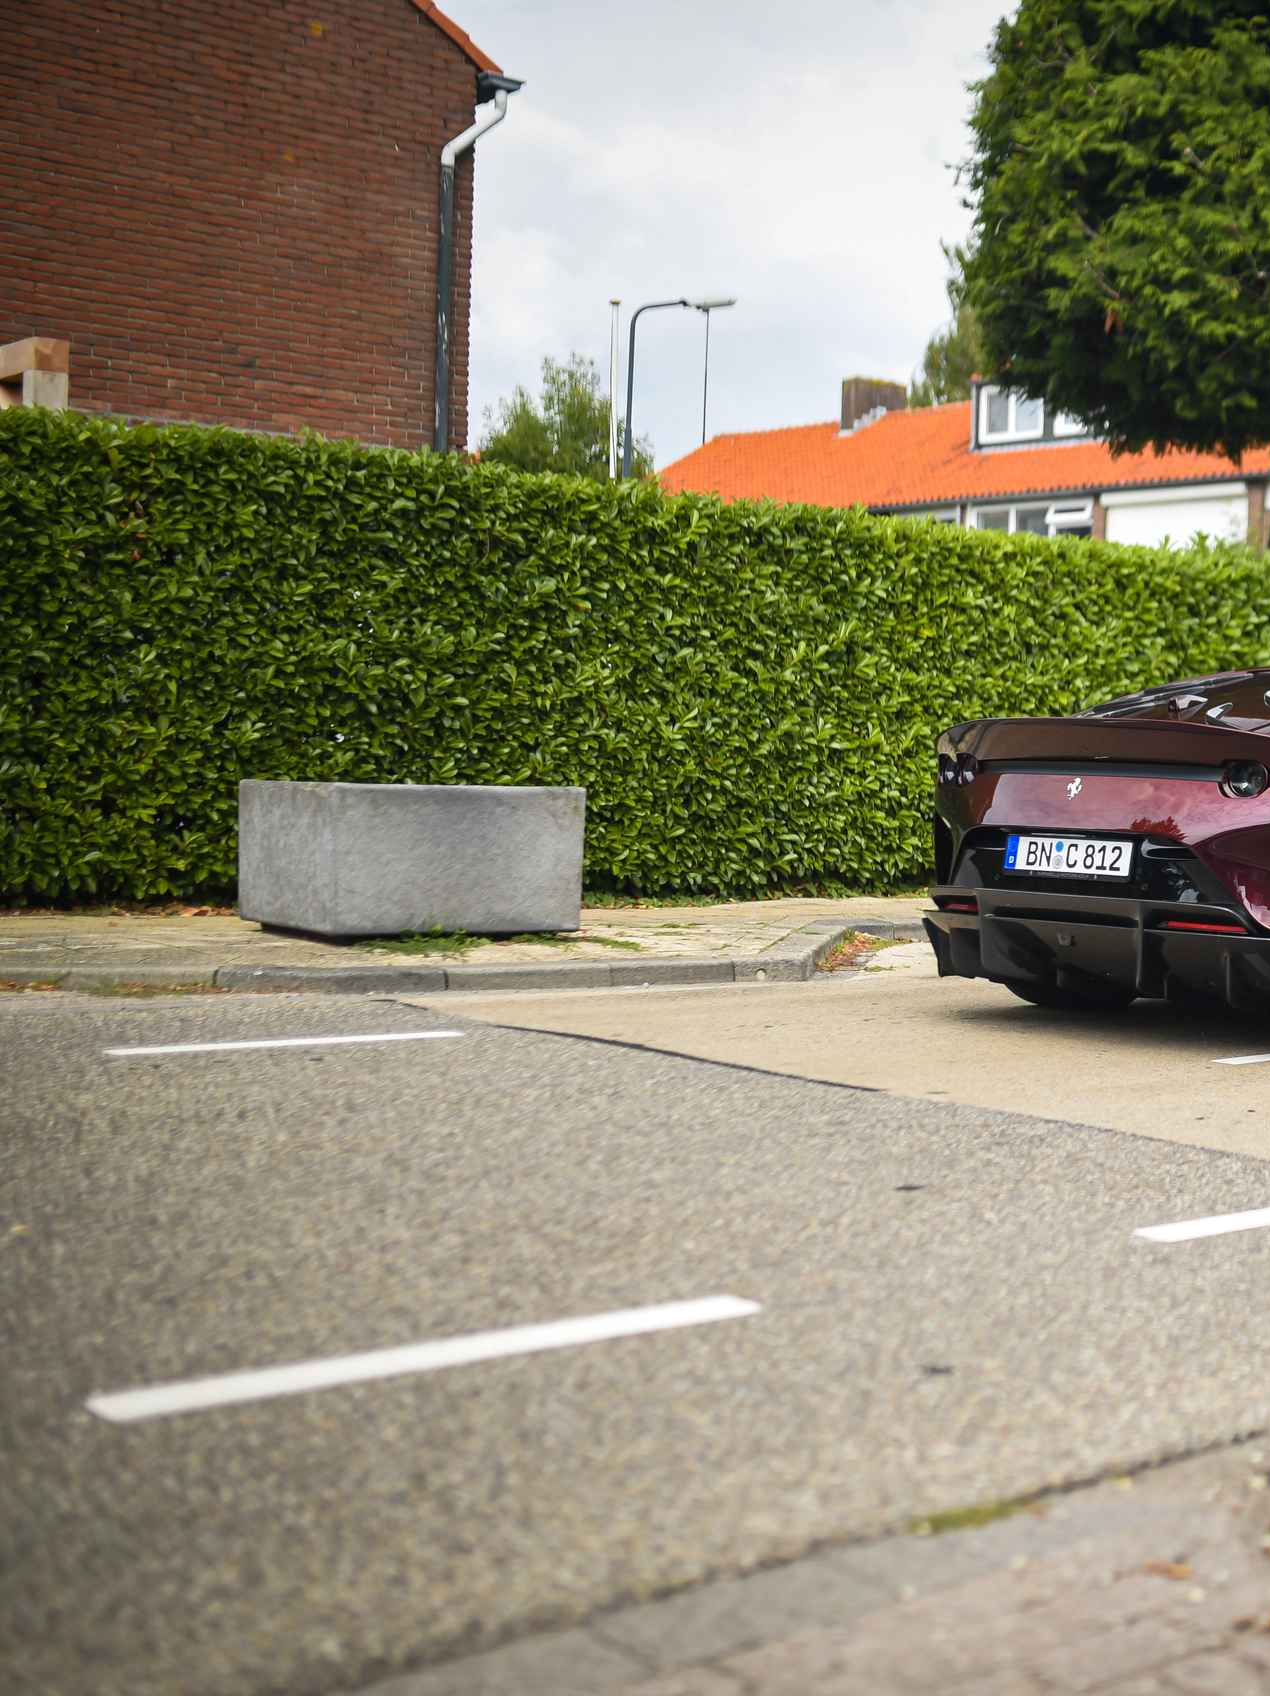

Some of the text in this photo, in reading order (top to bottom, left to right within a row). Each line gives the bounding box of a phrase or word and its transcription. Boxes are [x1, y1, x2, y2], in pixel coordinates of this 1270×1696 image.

[1008, 855, 1015, 864] D
[1026, 841, 1123, 871] BN C 812
